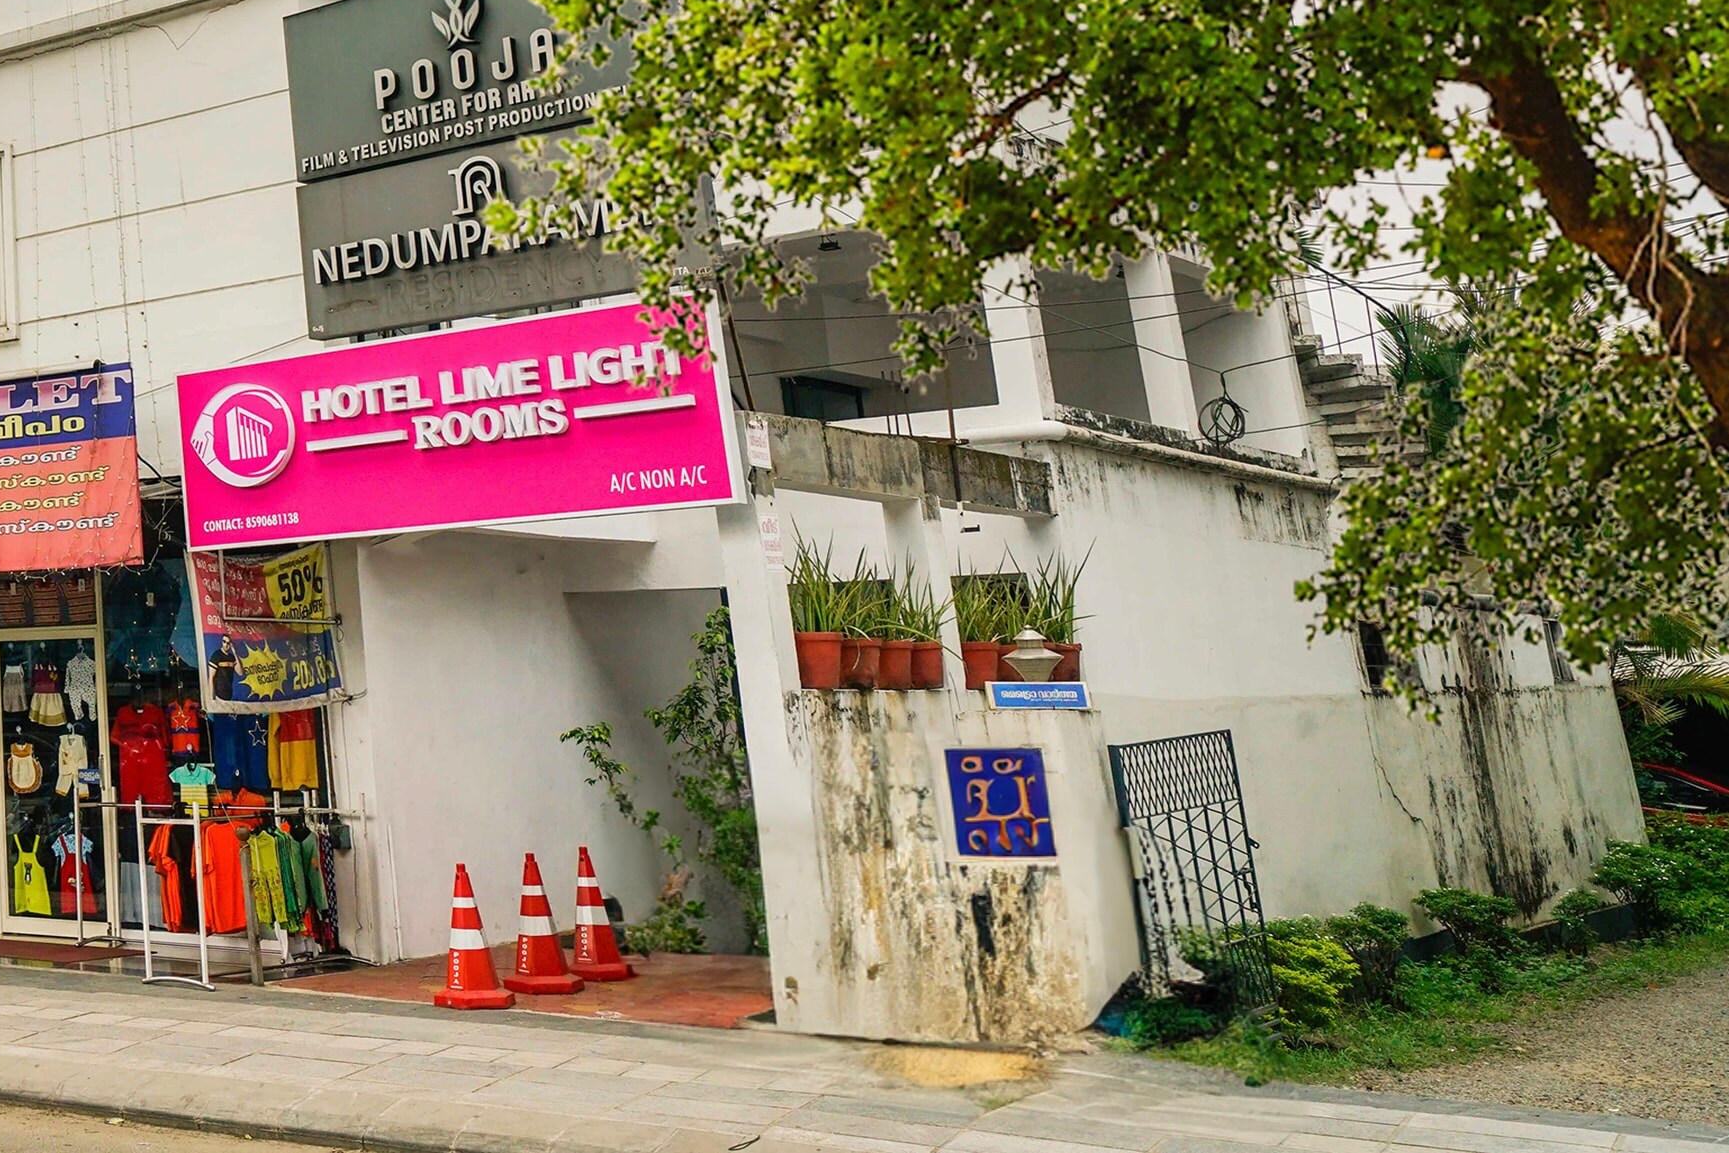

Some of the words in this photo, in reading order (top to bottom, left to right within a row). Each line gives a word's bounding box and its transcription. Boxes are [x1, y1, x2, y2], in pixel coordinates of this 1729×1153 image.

[373, 28, 558, 111] POOJA
[301, 151, 335, 173] FILM
[338, 149, 349, 165] &
[351, 127, 441, 162] TELEVISION
[444, 117, 485, 141] POST
[488, 91, 596, 132] PRODUCTION
[381, 98, 457, 135] CENTER
[461, 87, 503, 116] FOR
[312, 196, 662, 286] NEDUMPARAM
[301, 375, 434, 423] HOTEL
[438, 358, 542, 405] LIME
[547, 341, 682, 390] LIGHT
[412, 398, 570, 450] ROOMS
[610, 471, 637, 494] A/C
[640, 467, 674, 490] NON
[680, 465, 708, 487] A/C
[203, 518, 244, 533] CONTACT:
[245, 512, 299, 529] 8590681138
[277, 561, 323, 606] 50%
